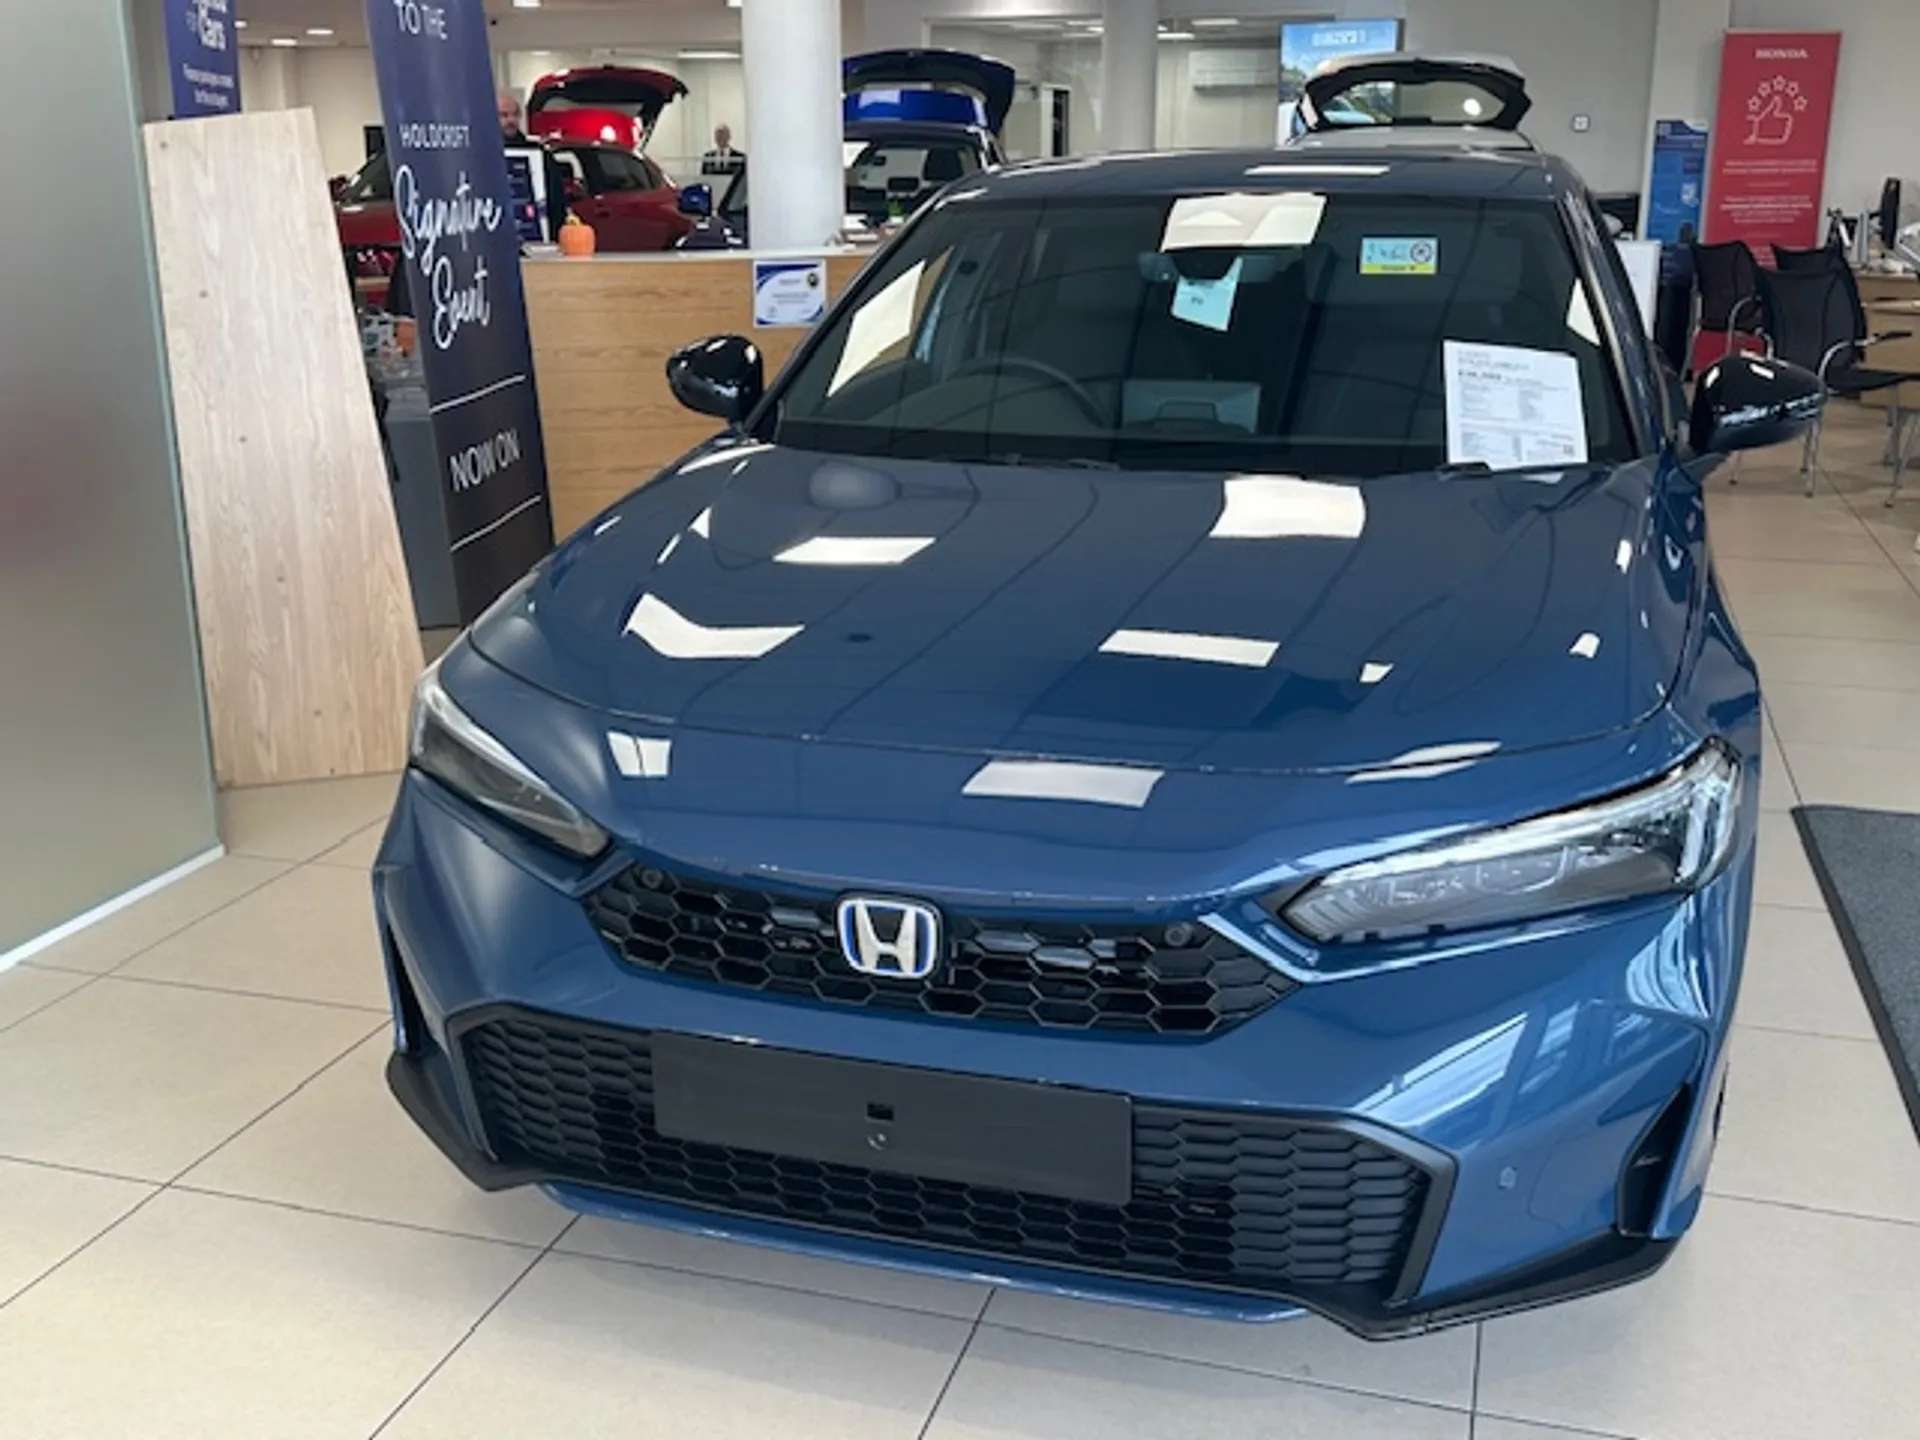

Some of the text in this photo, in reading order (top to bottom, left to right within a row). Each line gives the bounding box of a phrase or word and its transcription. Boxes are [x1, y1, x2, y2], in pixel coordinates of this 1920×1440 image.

[393, 0, 448, 40] TO THE
[1755, 47, 1809, 60] HONDA
[399, 121, 470, 149] HOLDCROFT
[394, 164, 502, 276] Signature
[432, 255, 491, 349] Event
[450, 427, 522, 492] NOW ON
